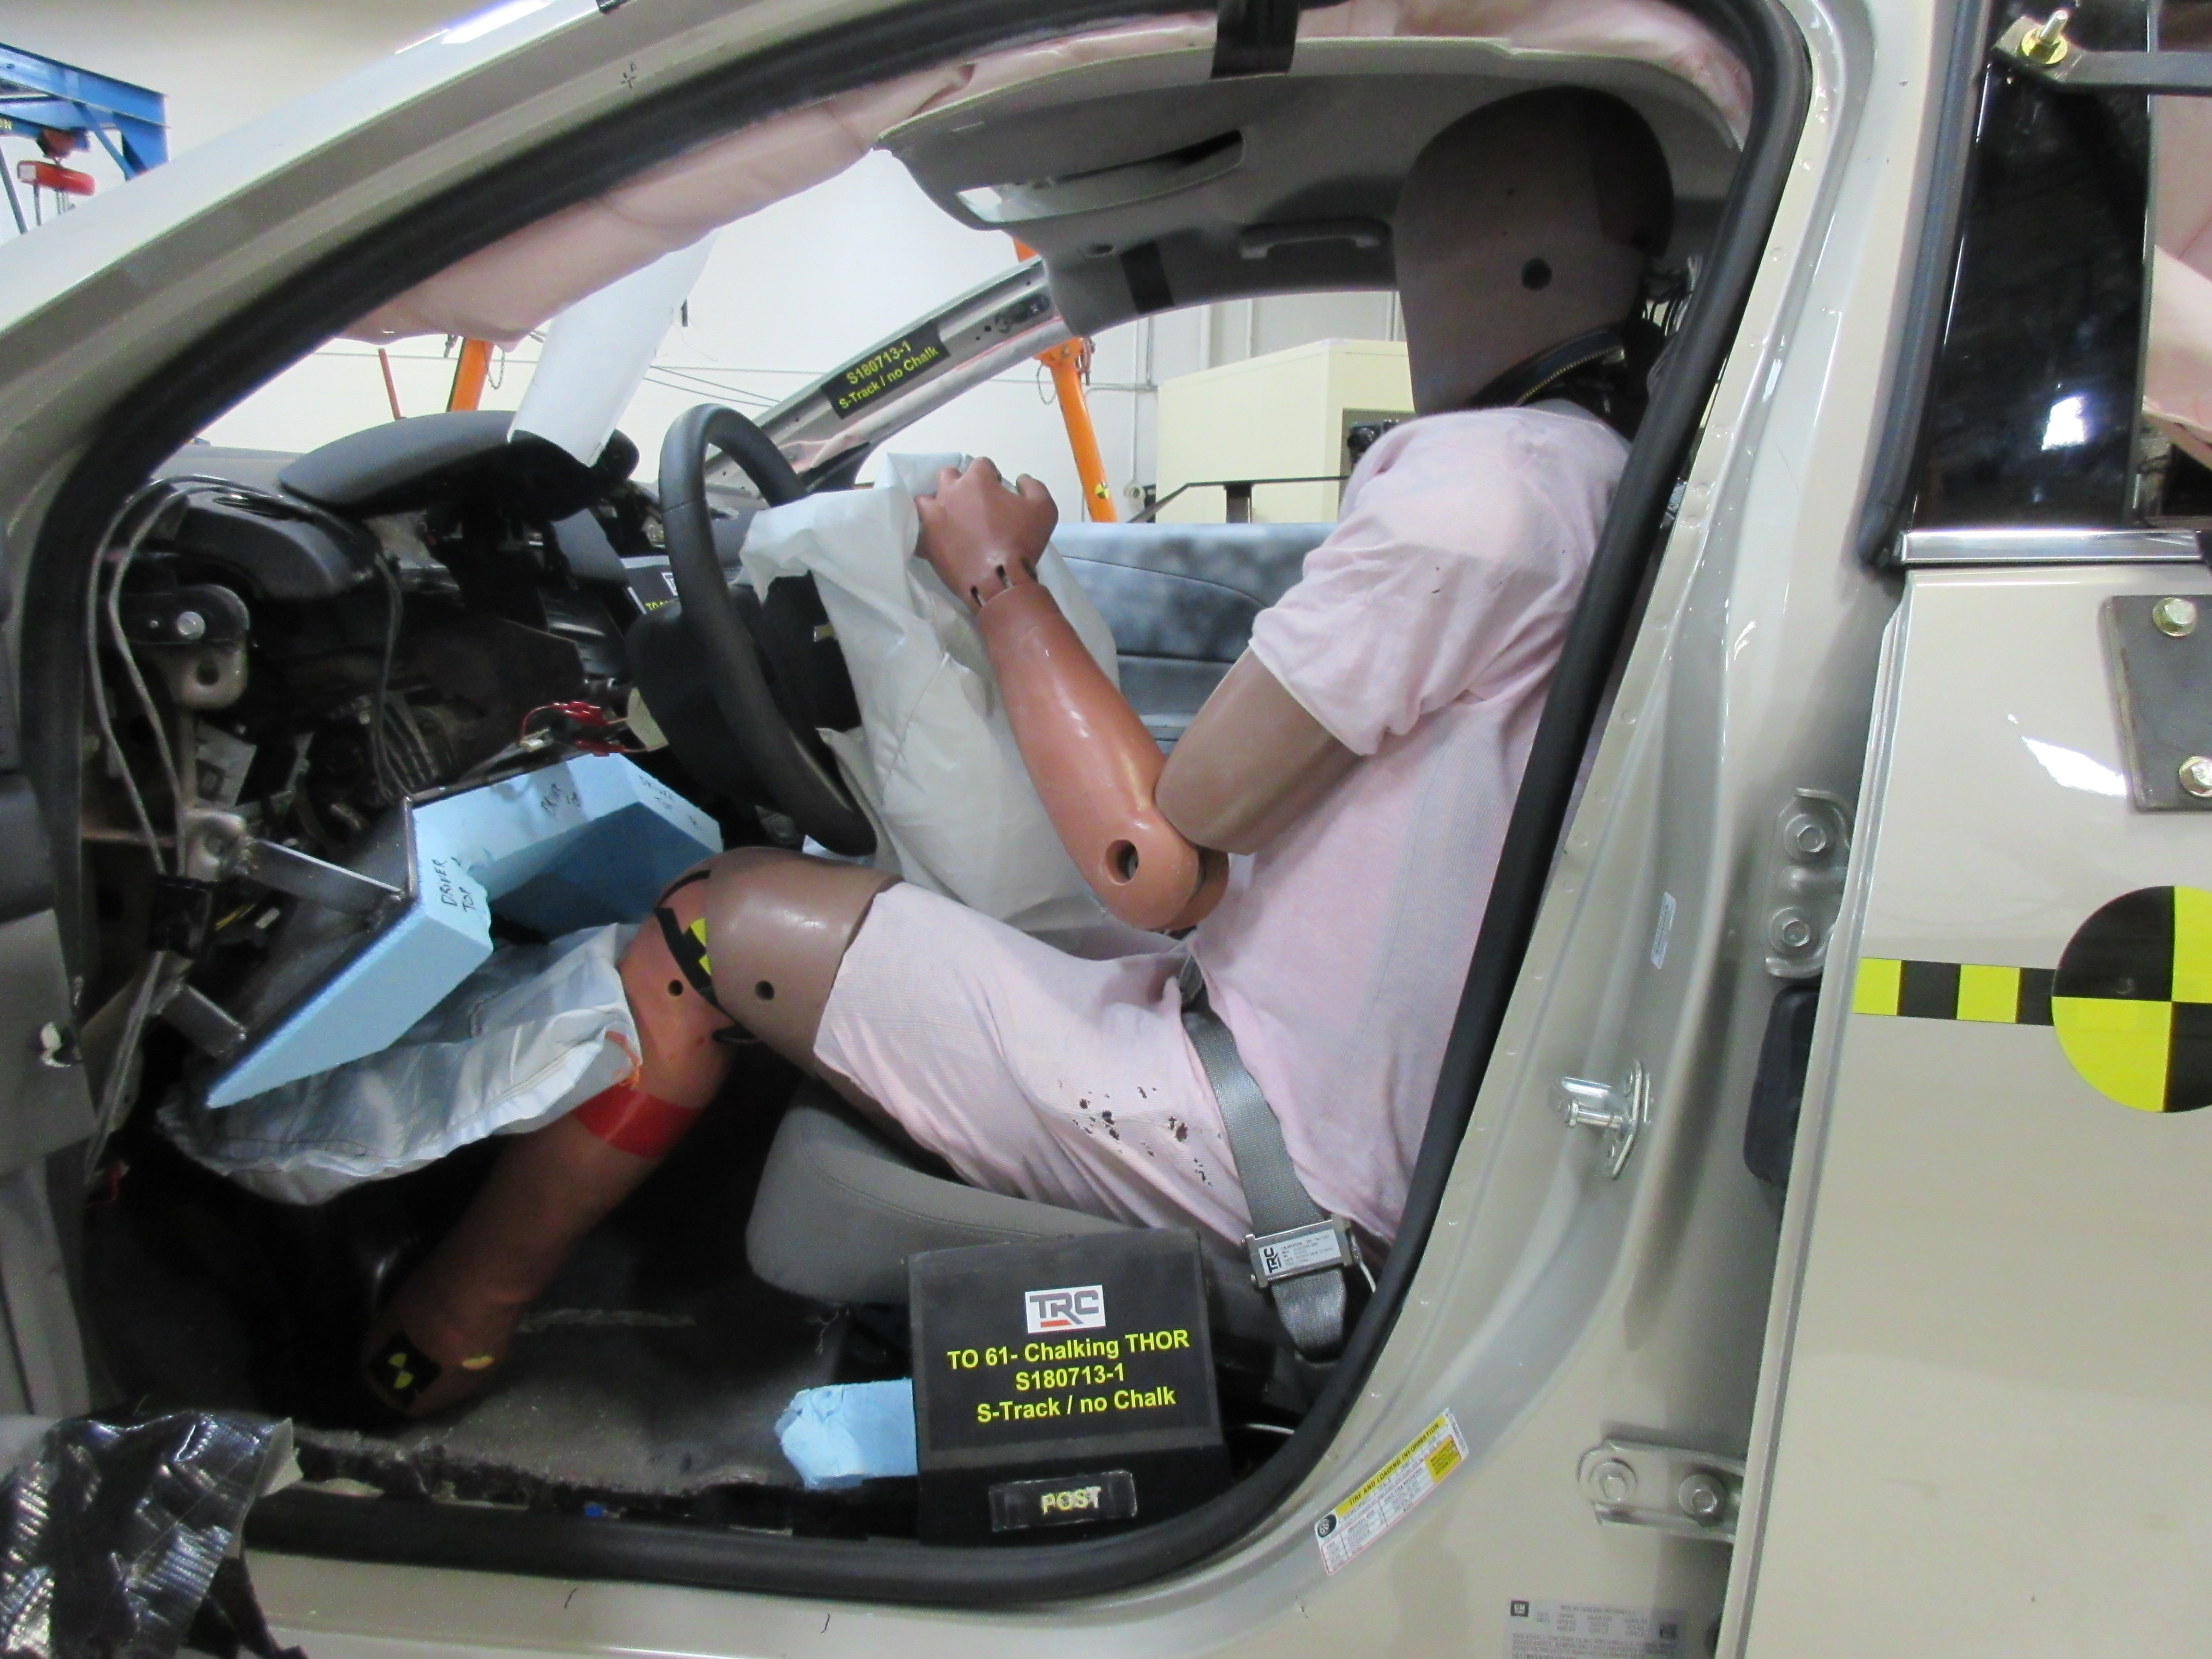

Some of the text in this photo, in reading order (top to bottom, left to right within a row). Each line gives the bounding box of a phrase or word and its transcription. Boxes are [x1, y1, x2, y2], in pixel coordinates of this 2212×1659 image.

[839, 347, 939, 409] S-Track / no Chalk
[846, 340, 911, 385] S180713-1
[432, 859, 457, 906] DRIVER
[459, 886, 475, 913] TOP
[1263, 1247, 1280, 1274] TRC
[1030, 1289, 1099, 1326] TRC
[947, 1329, 1190, 1370] TO 61- Chalking THOR
[1016, 1362, 1124, 1391] S180713-1
[977, 1385, 1177, 1423] S-Track / no Chalk
[1363, 1481, 1376, 1494] AND
[1376, 1460, 1401, 1482] LOADING
[1402, 1422, 1440, 1460] INFORMATION
[1041, 1486, 1101, 1515] POST
